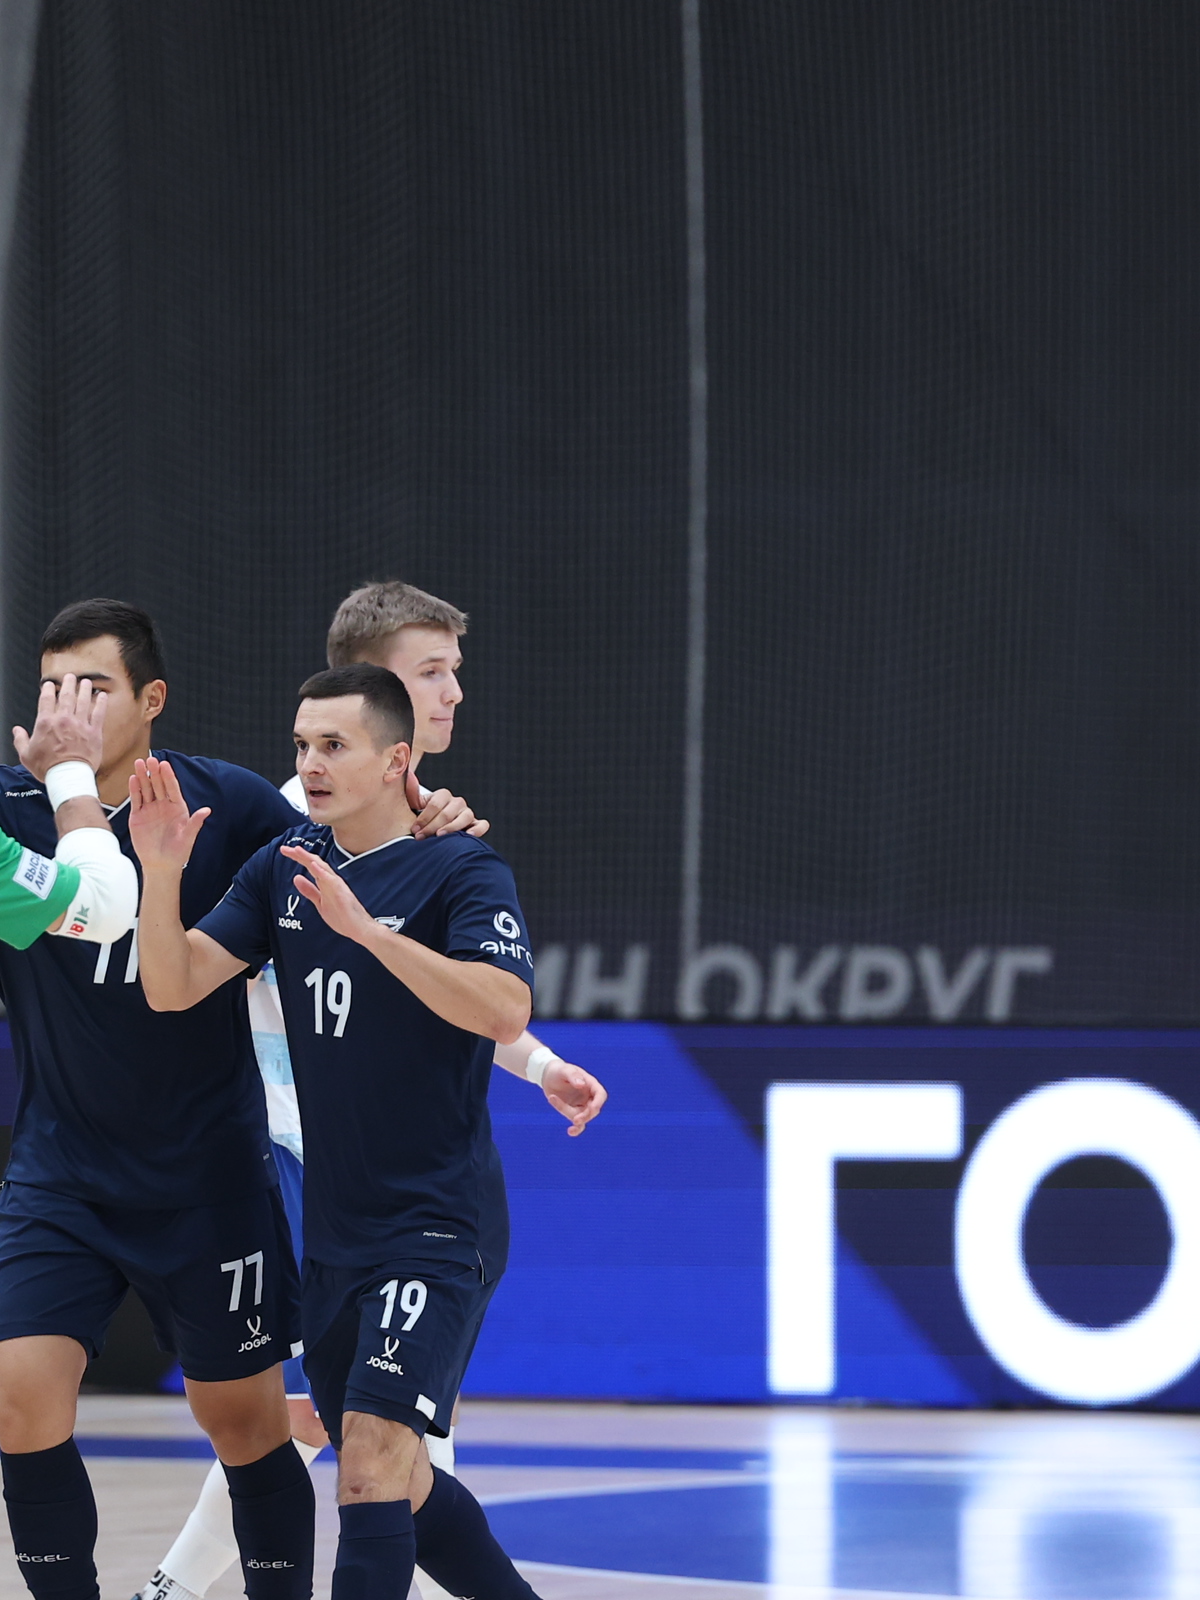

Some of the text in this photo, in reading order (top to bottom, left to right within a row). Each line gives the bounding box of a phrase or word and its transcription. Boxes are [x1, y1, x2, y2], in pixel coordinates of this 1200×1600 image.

[304, 967, 352, 1038] 19
[766, 1078, 1200, 1404] ГО
[220, 1250, 264, 1312] 77
[379, 1279, 428, 1331] 19
